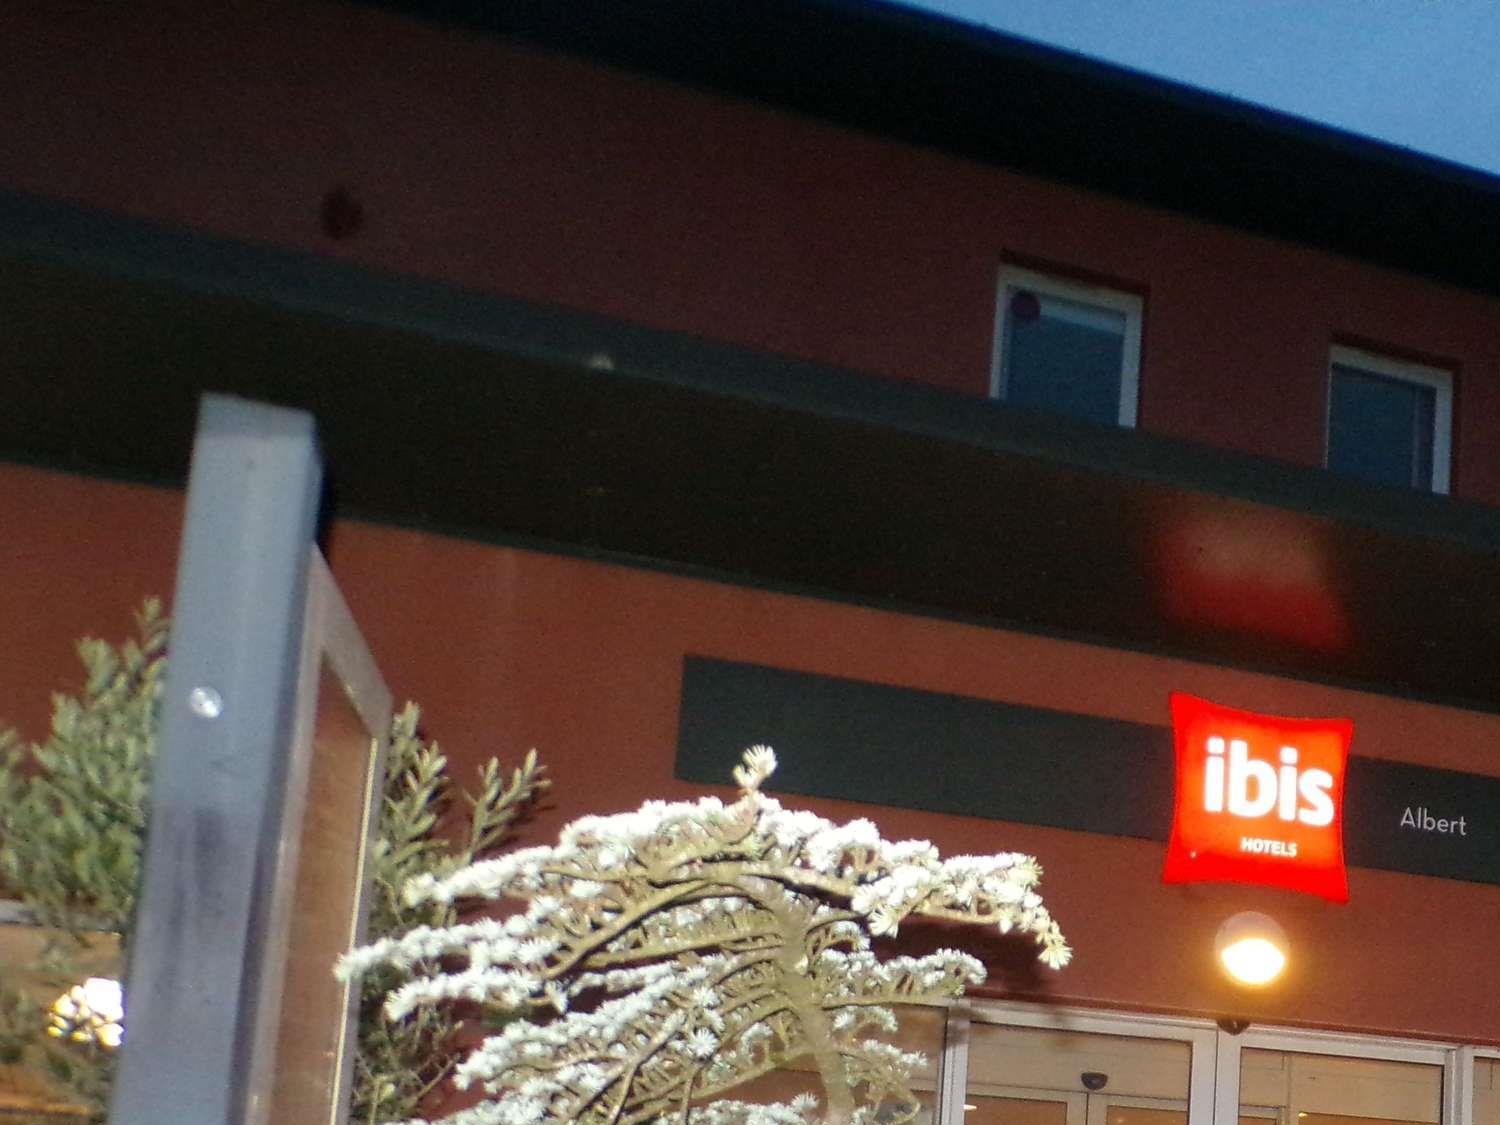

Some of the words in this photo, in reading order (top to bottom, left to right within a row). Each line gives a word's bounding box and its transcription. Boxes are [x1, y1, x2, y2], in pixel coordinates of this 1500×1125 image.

[1203, 736, 1335, 827] ibis
[1400, 807, 1467, 836] Albert
[1239, 836, 1298, 858] HOTELS
